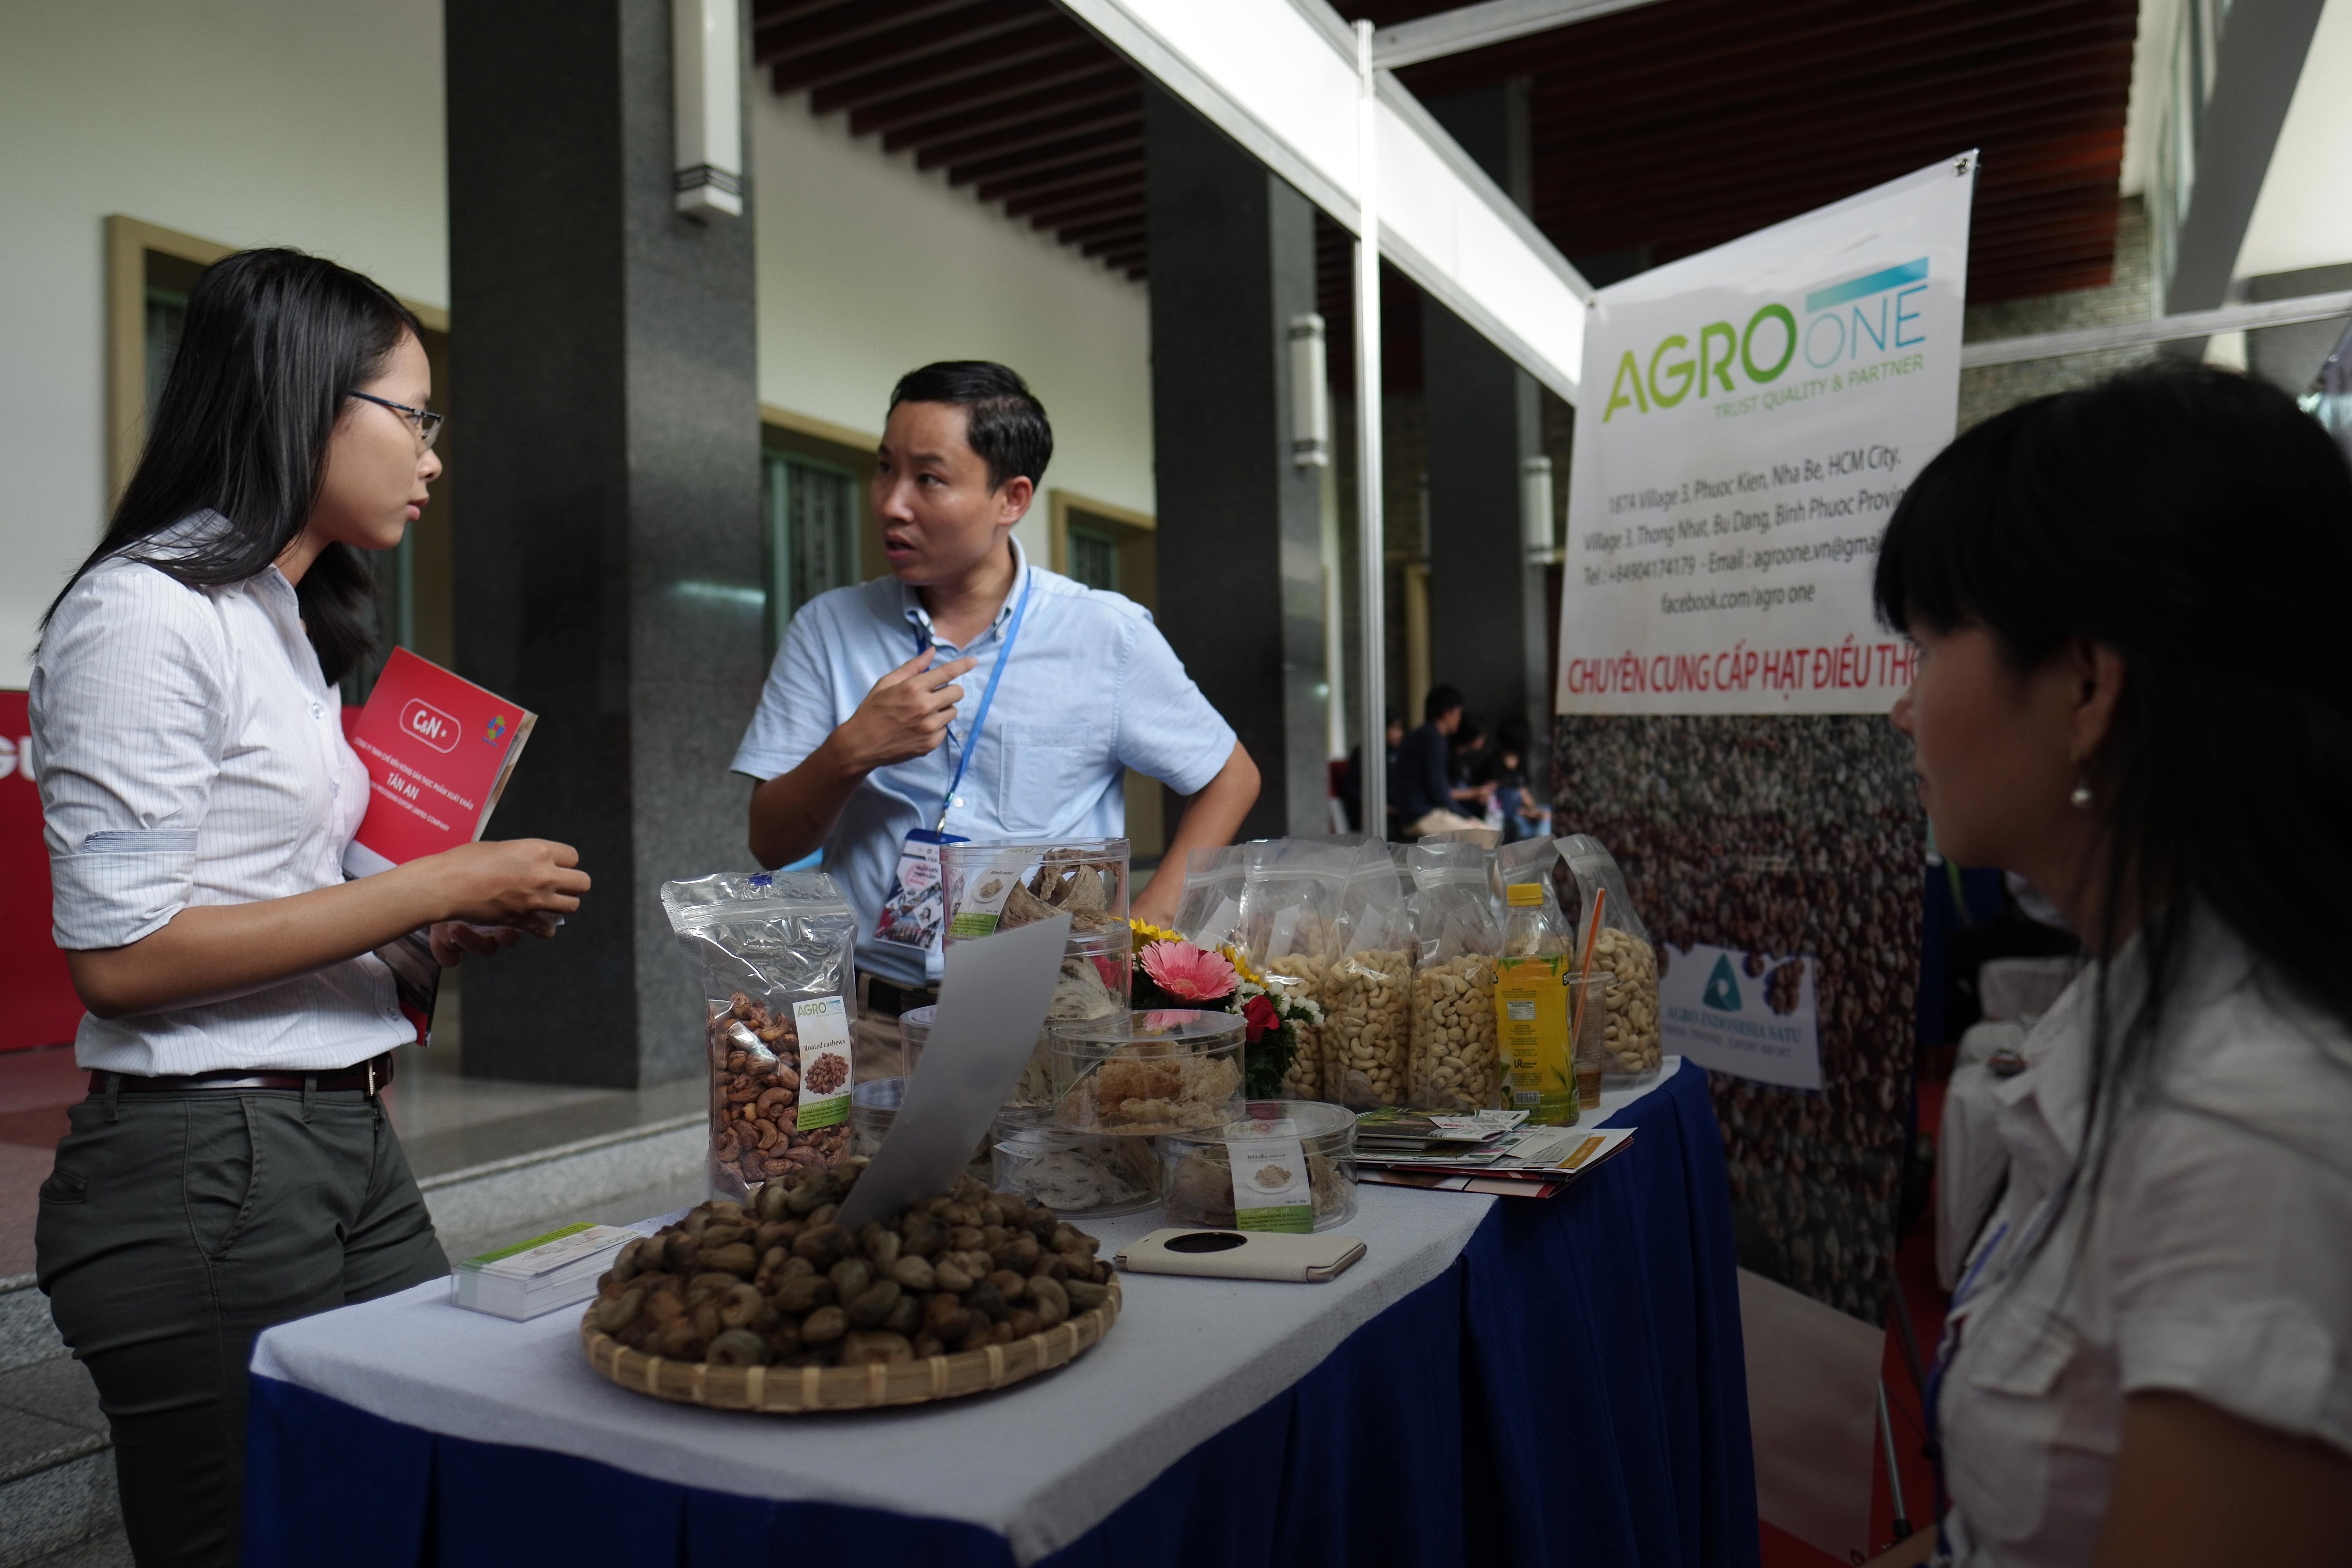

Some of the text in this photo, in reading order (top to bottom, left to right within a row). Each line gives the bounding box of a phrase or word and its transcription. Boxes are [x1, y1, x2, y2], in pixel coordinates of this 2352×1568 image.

[1602, 285, 1928, 423] AGRO ONE
[1714, 353, 1924, 419] TRUST QUALITY & PARTNER
[1638, 488, 1678, 512] Village
[1694, 477, 1734, 500] Phuoc
[1771, 462, 1800, 487] Nha
[1828, 449, 1864, 477] HCM
[1867, 444, 1902, 473] City.
[1637, 524, 1675, 548] Thong
[1713, 512, 1730, 537] Bu
[1774, 501, 1806, 526] Binh
[1809, 495, 1855, 521] Phuoc
[1858, 484, 1906, 513] Provin
[1786, 584, 1815, 604] one
[1568, 649, 1646, 694] CHUYÊN
[1651, 653, 1710, 692] CUNG
[1713, 638, 1759, 691] CẤP
[1762, 646, 1809, 702] HẠT
[387, 772, 405, 792] TÂN
[403, 784, 419, 800] AN
[798, 1002, 842, 1017] AGRO ONE
[804, 1039, 845, 1051] Roated cashews
[1228, 1123, 1270, 1134] AGRO
